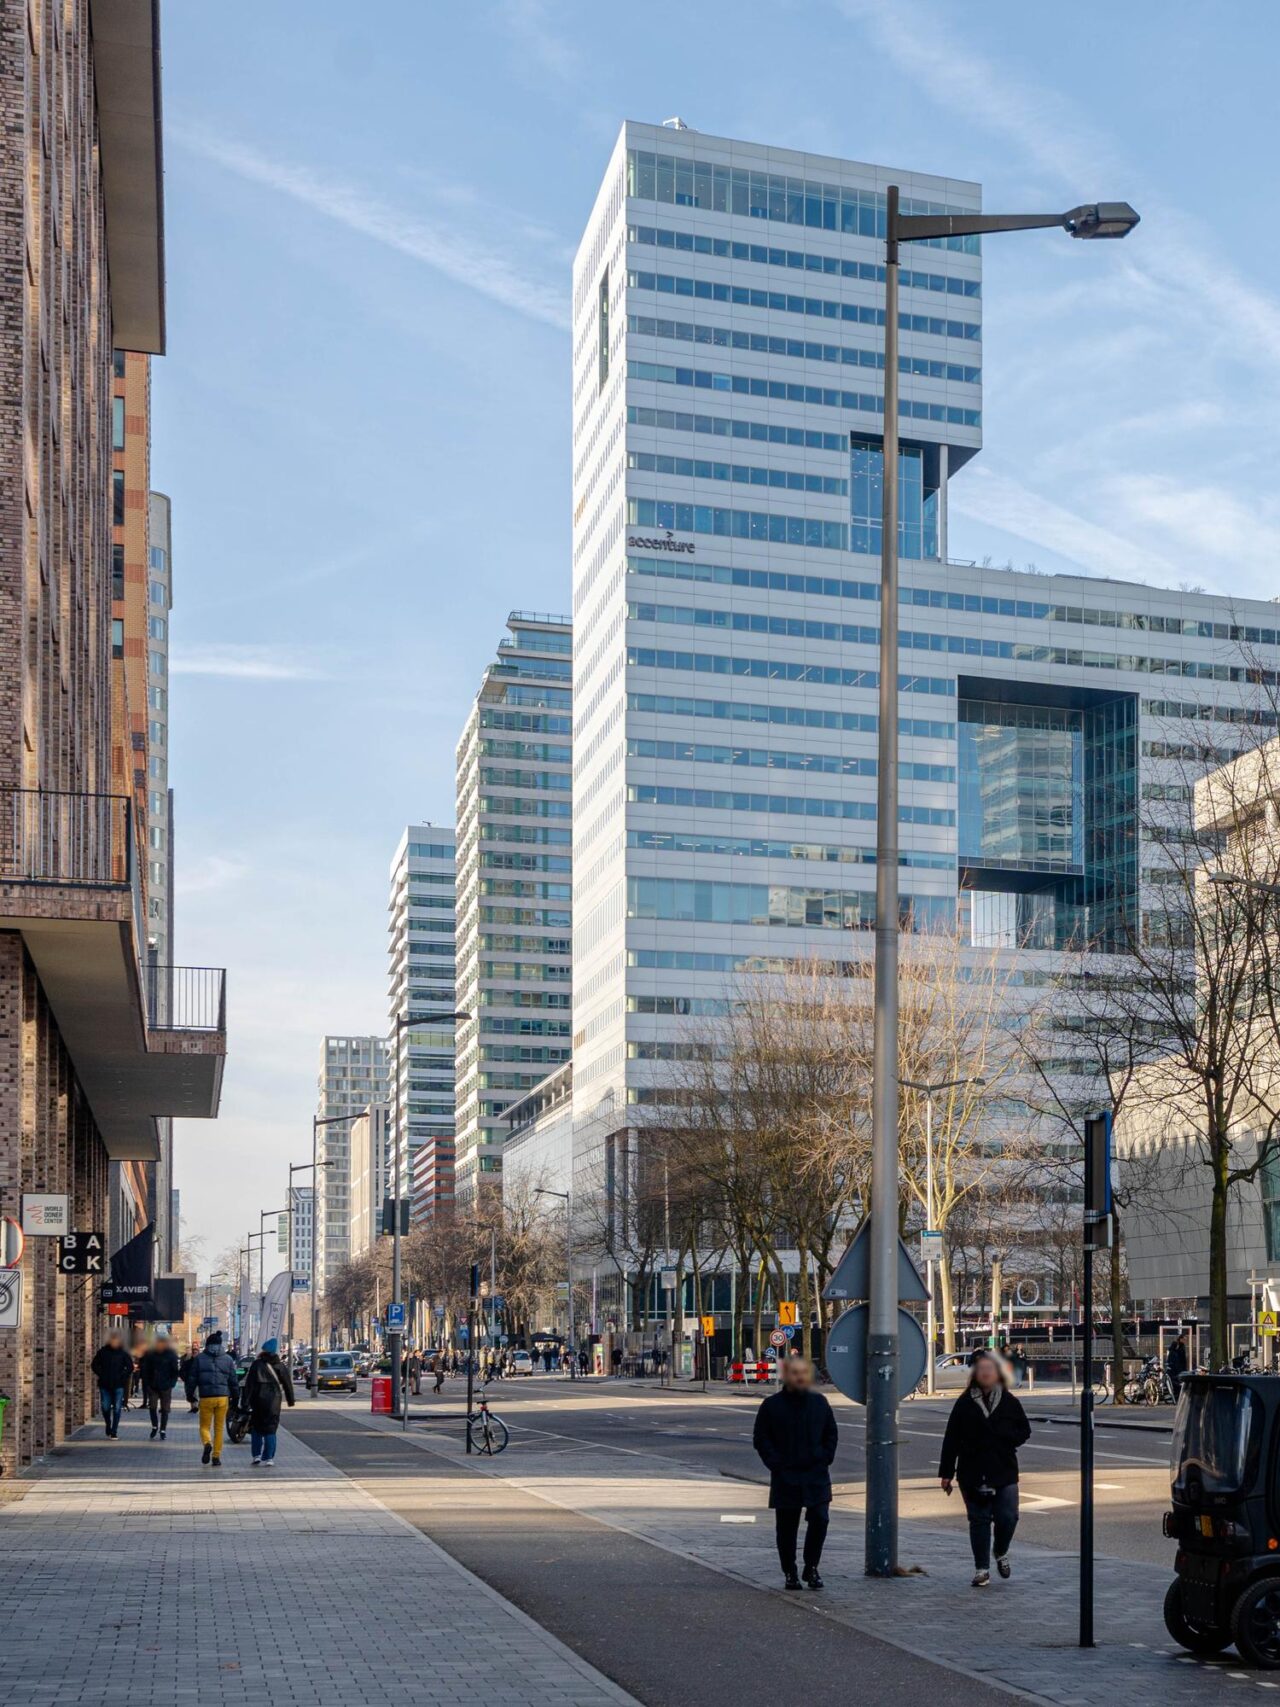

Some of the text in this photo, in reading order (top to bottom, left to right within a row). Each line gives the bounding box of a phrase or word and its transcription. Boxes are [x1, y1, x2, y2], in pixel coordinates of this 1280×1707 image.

[628, 535, 695, 554] accenture
[116, 1286, 149, 1294] XAVIER
[391, 1305, 401, 1317] P
